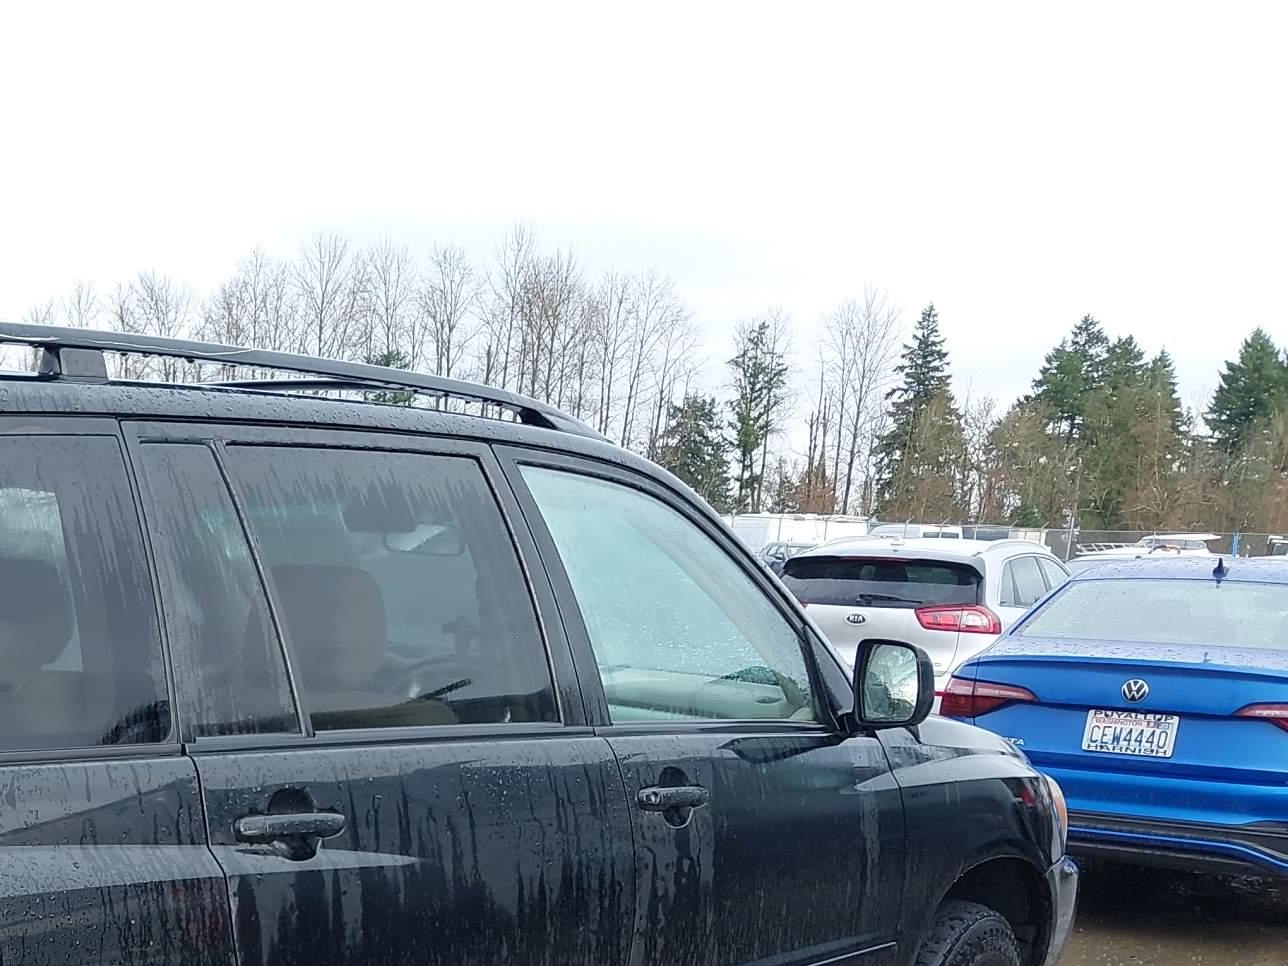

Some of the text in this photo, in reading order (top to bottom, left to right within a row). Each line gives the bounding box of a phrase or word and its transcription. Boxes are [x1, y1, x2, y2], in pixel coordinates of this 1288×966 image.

[1093, 710, 1174, 722] PUYALLUP
[1095, 717, 1143, 727] WASHINGTON
[1089, 725, 1169, 749] CEW4440
[1087, 743, 1168, 755] HARNISH
